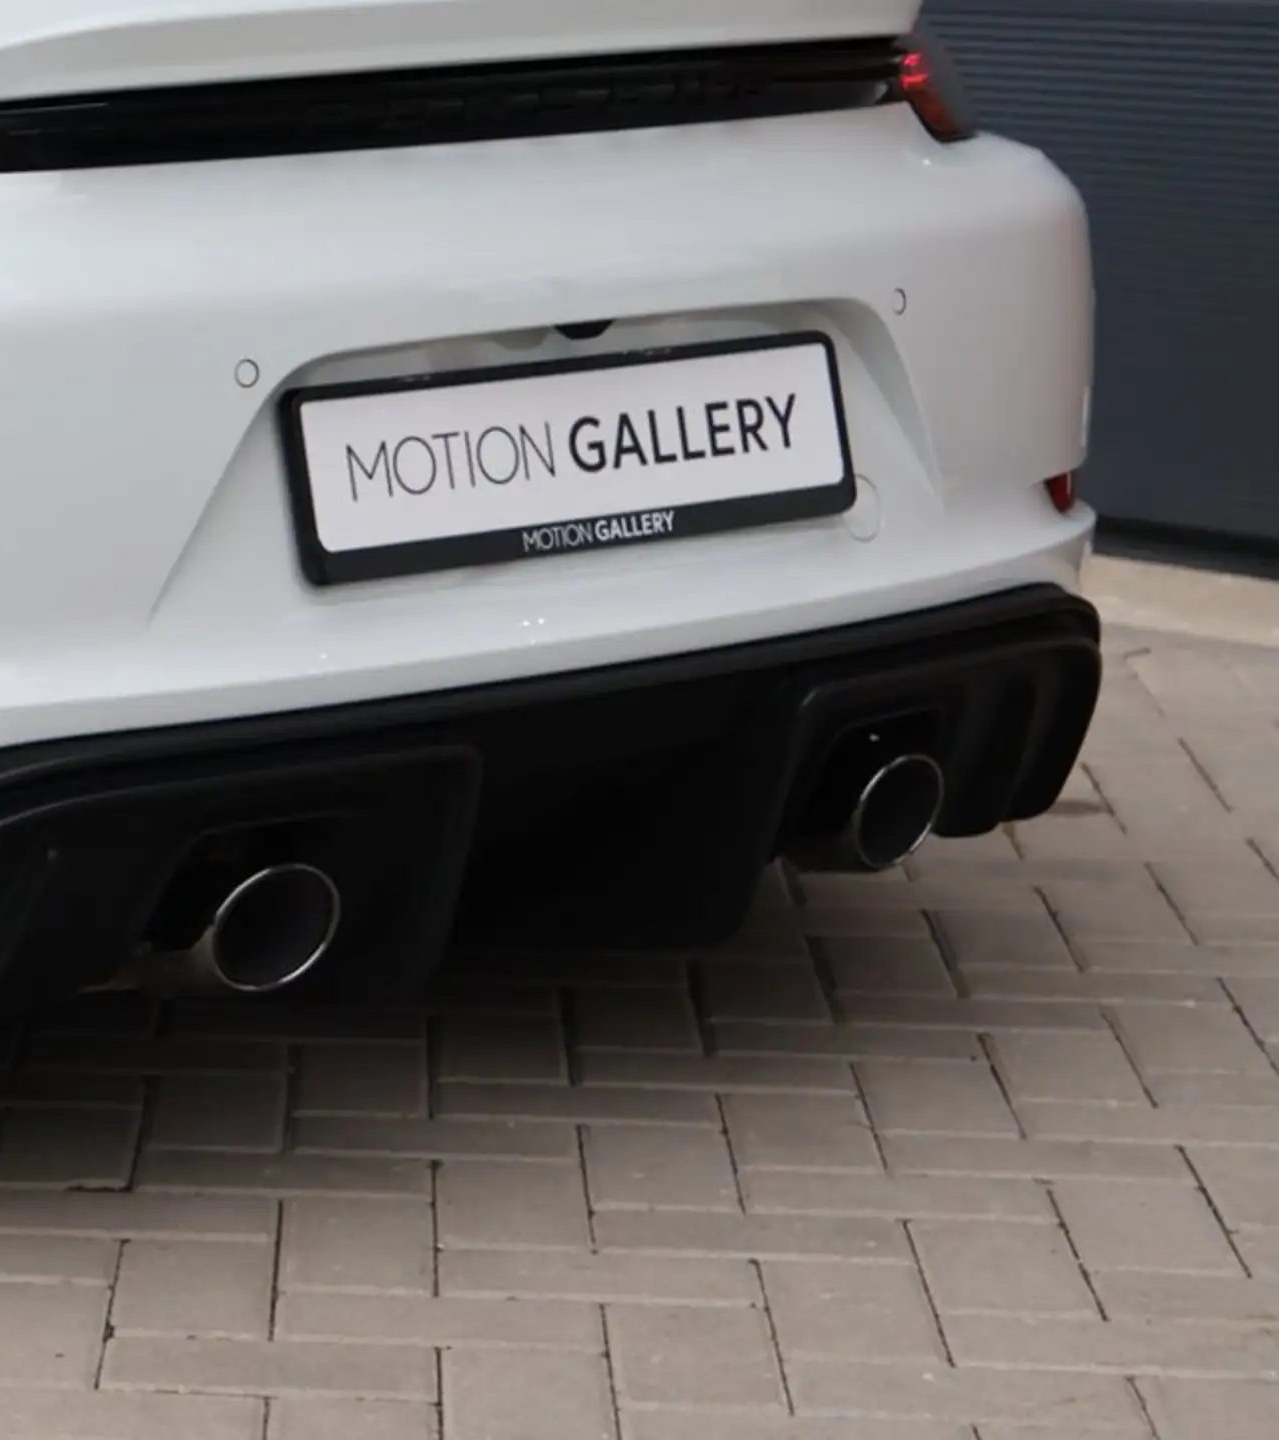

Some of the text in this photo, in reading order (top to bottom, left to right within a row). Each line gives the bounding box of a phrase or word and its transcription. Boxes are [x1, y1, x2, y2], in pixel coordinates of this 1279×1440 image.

[345, 393, 796, 502] MOTION GALLERY
[522, 510, 674, 552] MOTION GALLERY
